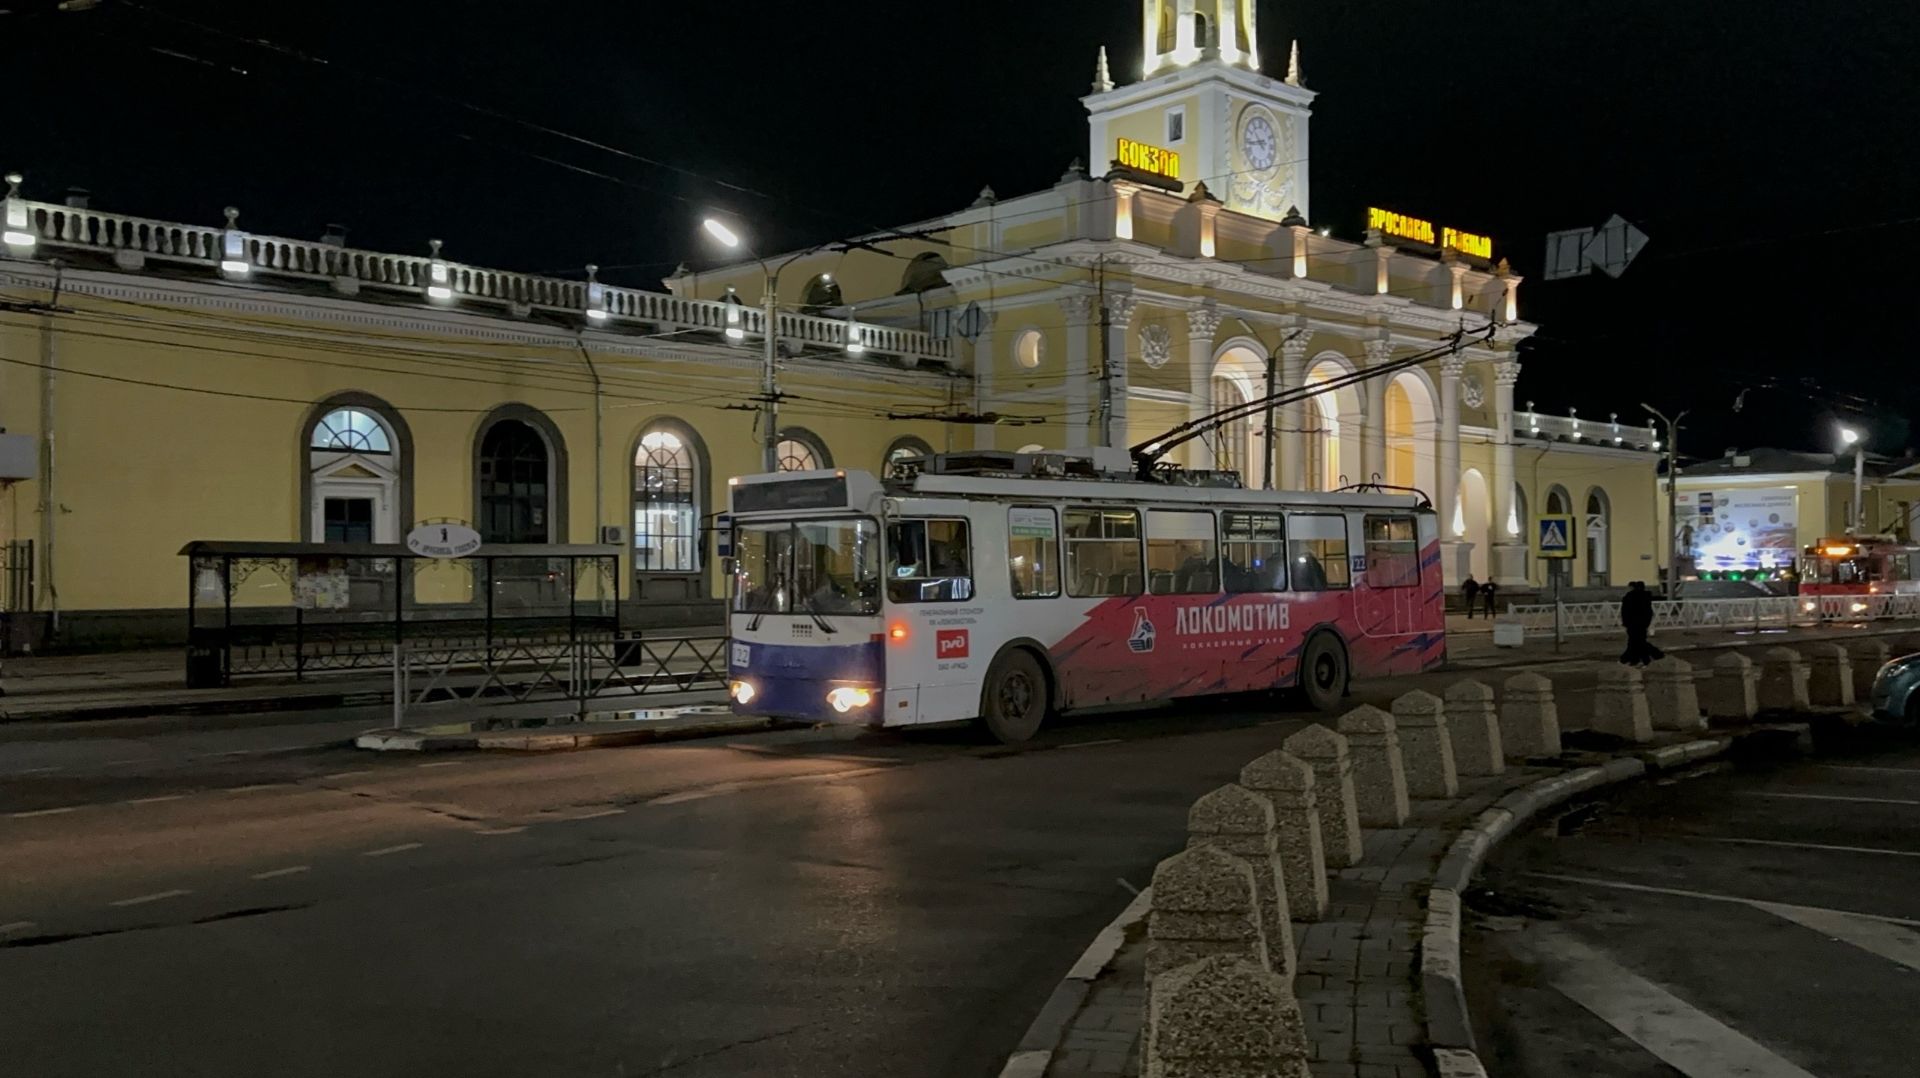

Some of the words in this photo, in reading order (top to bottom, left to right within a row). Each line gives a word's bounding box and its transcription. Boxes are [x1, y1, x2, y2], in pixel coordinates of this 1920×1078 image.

[1118, 138, 1180, 178] ВОКЗАЛ
[1368, 207, 1435, 244] ЯРОСЛАВЛЬ
[1176, 604, 1290, 635] ЛОКОМОТИВ
